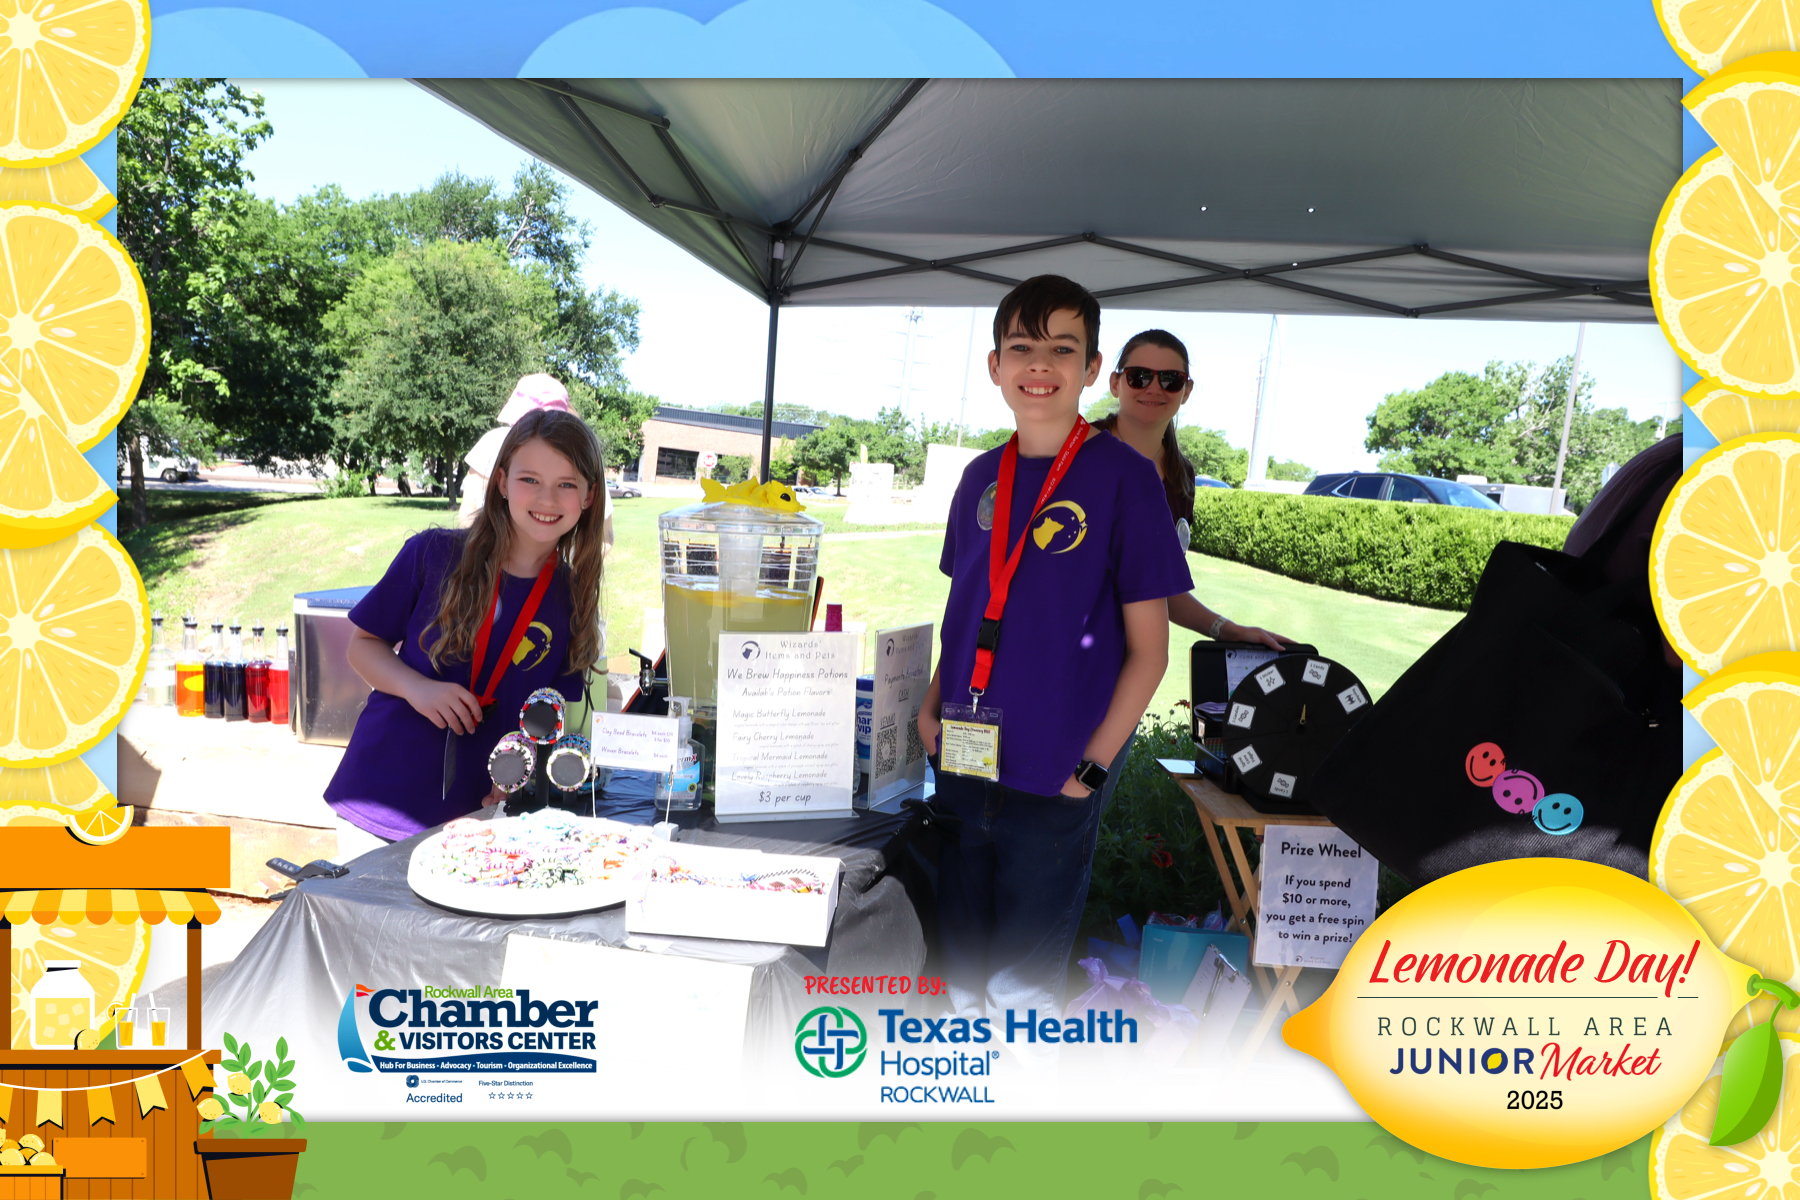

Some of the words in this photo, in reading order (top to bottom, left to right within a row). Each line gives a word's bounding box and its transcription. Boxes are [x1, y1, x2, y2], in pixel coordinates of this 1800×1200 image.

[727, 668, 743, 679] We
[746, 668, 770, 679] Brew
[772, 669, 814, 683] Happiness
[818, 668, 848, 679] Potions
[742, 687, 774, 697] Availabe
[777, 688, 801, 696] Potion
[732, 709, 754, 721] Magic
[756, 708, 790, 720] Butterfly
[626, 729, 647, 737] Bracelets
[732, 732, 751, 744] Fairy
[754, 732, 778, 744] Cherry
[780, 732, 814, 741] Lemonade
[618, 748, 639, 756] Bracelets
[794, 751, 828, 761] Lemonade
[794, 771, 828, 779] Lemonade
[759, 791, 771, 803] $3
[774, 793, 792, 807] per
[795, 793, 812, 806] cup
[1281, 842, 1314, 856] Prize
[1319, 843, 1361, 858] Wheel
[1285, 875, 1295, 885] If
[1297, 878, 1316, 889] you
[1319, 878, 1351, 890] spend
[1282, 893, 1302, 904] $10
[1306, 895, 1317, 904] or
[1320, 896, 1351, 908] more,
[1266, 914, 1285, 923] you
[1289, 914, 1306, 925] get
[1318, 913, 1339, 924] free
[1342, 916, 1364, 928] spin
[1293, 931, 1310, 940] win
[1323, 933, 1353, 944] prize!
